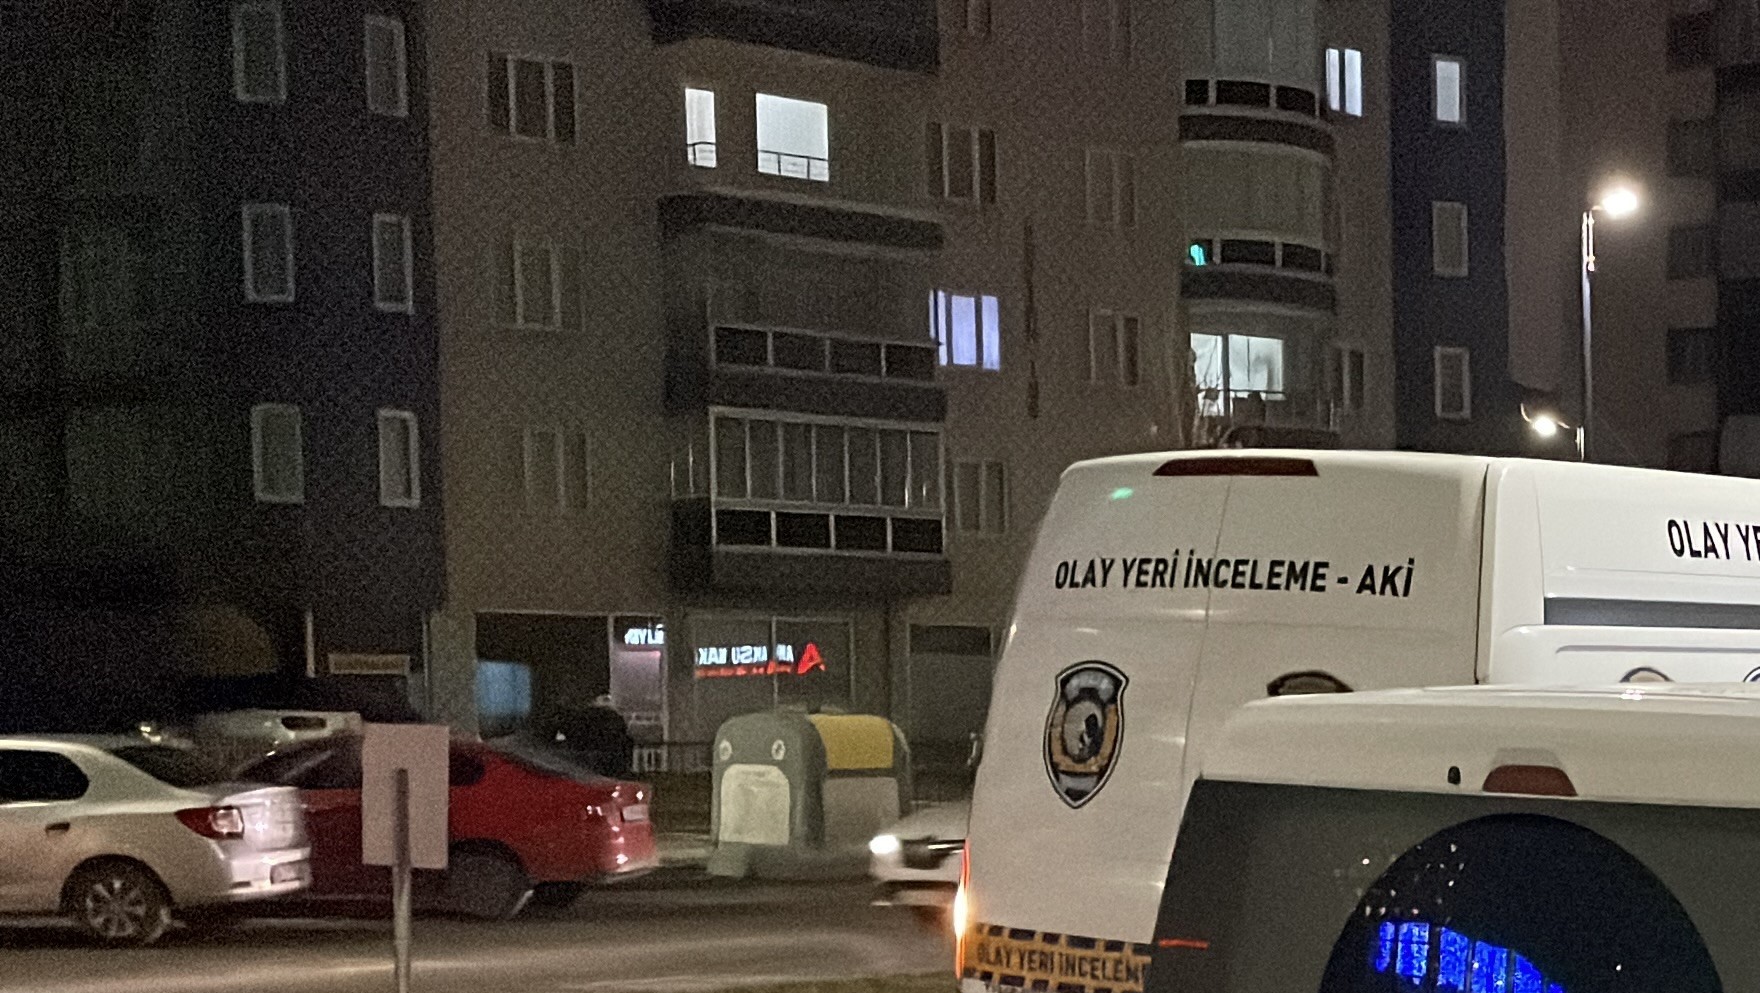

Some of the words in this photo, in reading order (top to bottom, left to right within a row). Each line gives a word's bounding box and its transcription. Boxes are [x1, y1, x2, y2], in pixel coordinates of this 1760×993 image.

[1668, 519, 1730, 560] OLAY
[1055, 558, 1115, 589] OLAY
[1122, 548, 1179, 588] YERİ
[1184, 548, 1329, 592] İNCELEME
[1336, 576, 1348, 585] -
[1356, 557, 1415, 597] AKİ
[977, 942, 1013, 969] OLAY
